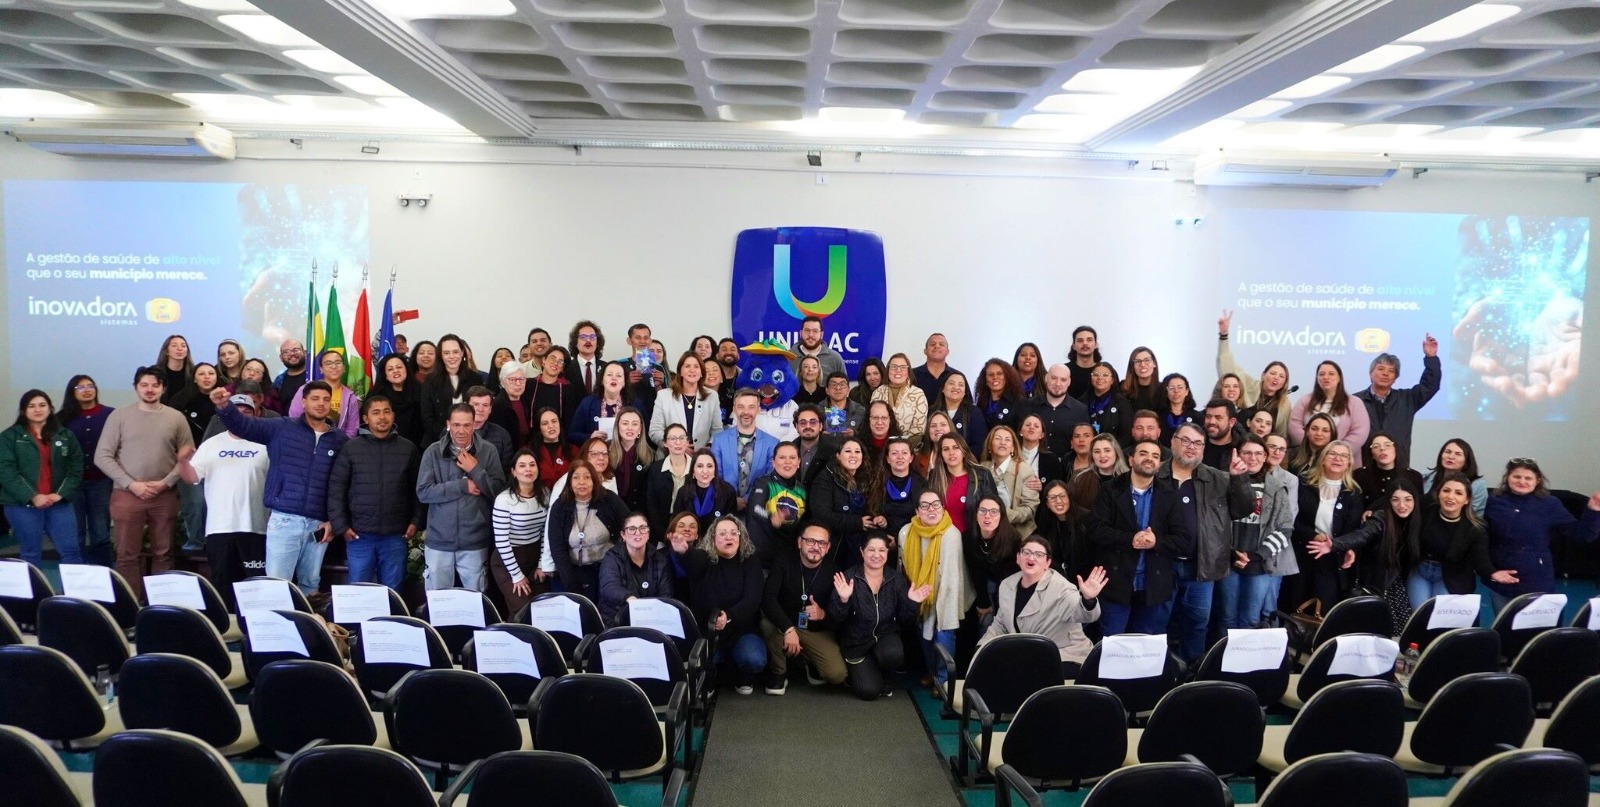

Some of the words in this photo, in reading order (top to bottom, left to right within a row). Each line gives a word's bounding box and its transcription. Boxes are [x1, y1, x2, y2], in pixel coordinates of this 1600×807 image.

[26, 252, 35, 263] A
[37, 252, 80, 267] gestão
[83, 253, 100, 264] de
[102, 253, 141, 264] saúde
[143, 254, 160, 265] de
[163, 254, 189, 266] alto
[26, 269, 51, 281] que
[53, 269, 63, 279] o
[64, 269, 87, 279] seu
[89, 267, 154, 283] município
[155, 270, 208, 281] merece.
[1238, 281, 1247, 292] A
[1249, 282, 1293, 295] gestão
[1296, 283, 1313, 294] de
[1315, 283, 1355, 295] saúde
[1357, 284, 1374, 295] de
[1377, 285, 1402, 296] alto
[1237, 298, 1262, 311] que
[1264, 298, 1274, 308] o
[1276, 299, 1299, 309] seu
[1301, 297, 1367, 313] município
[1368, 301, 1421, 311] merece.
[758, 330, 859, 353] UNIAC
[218, 450, 259, 458] OAKLEY
